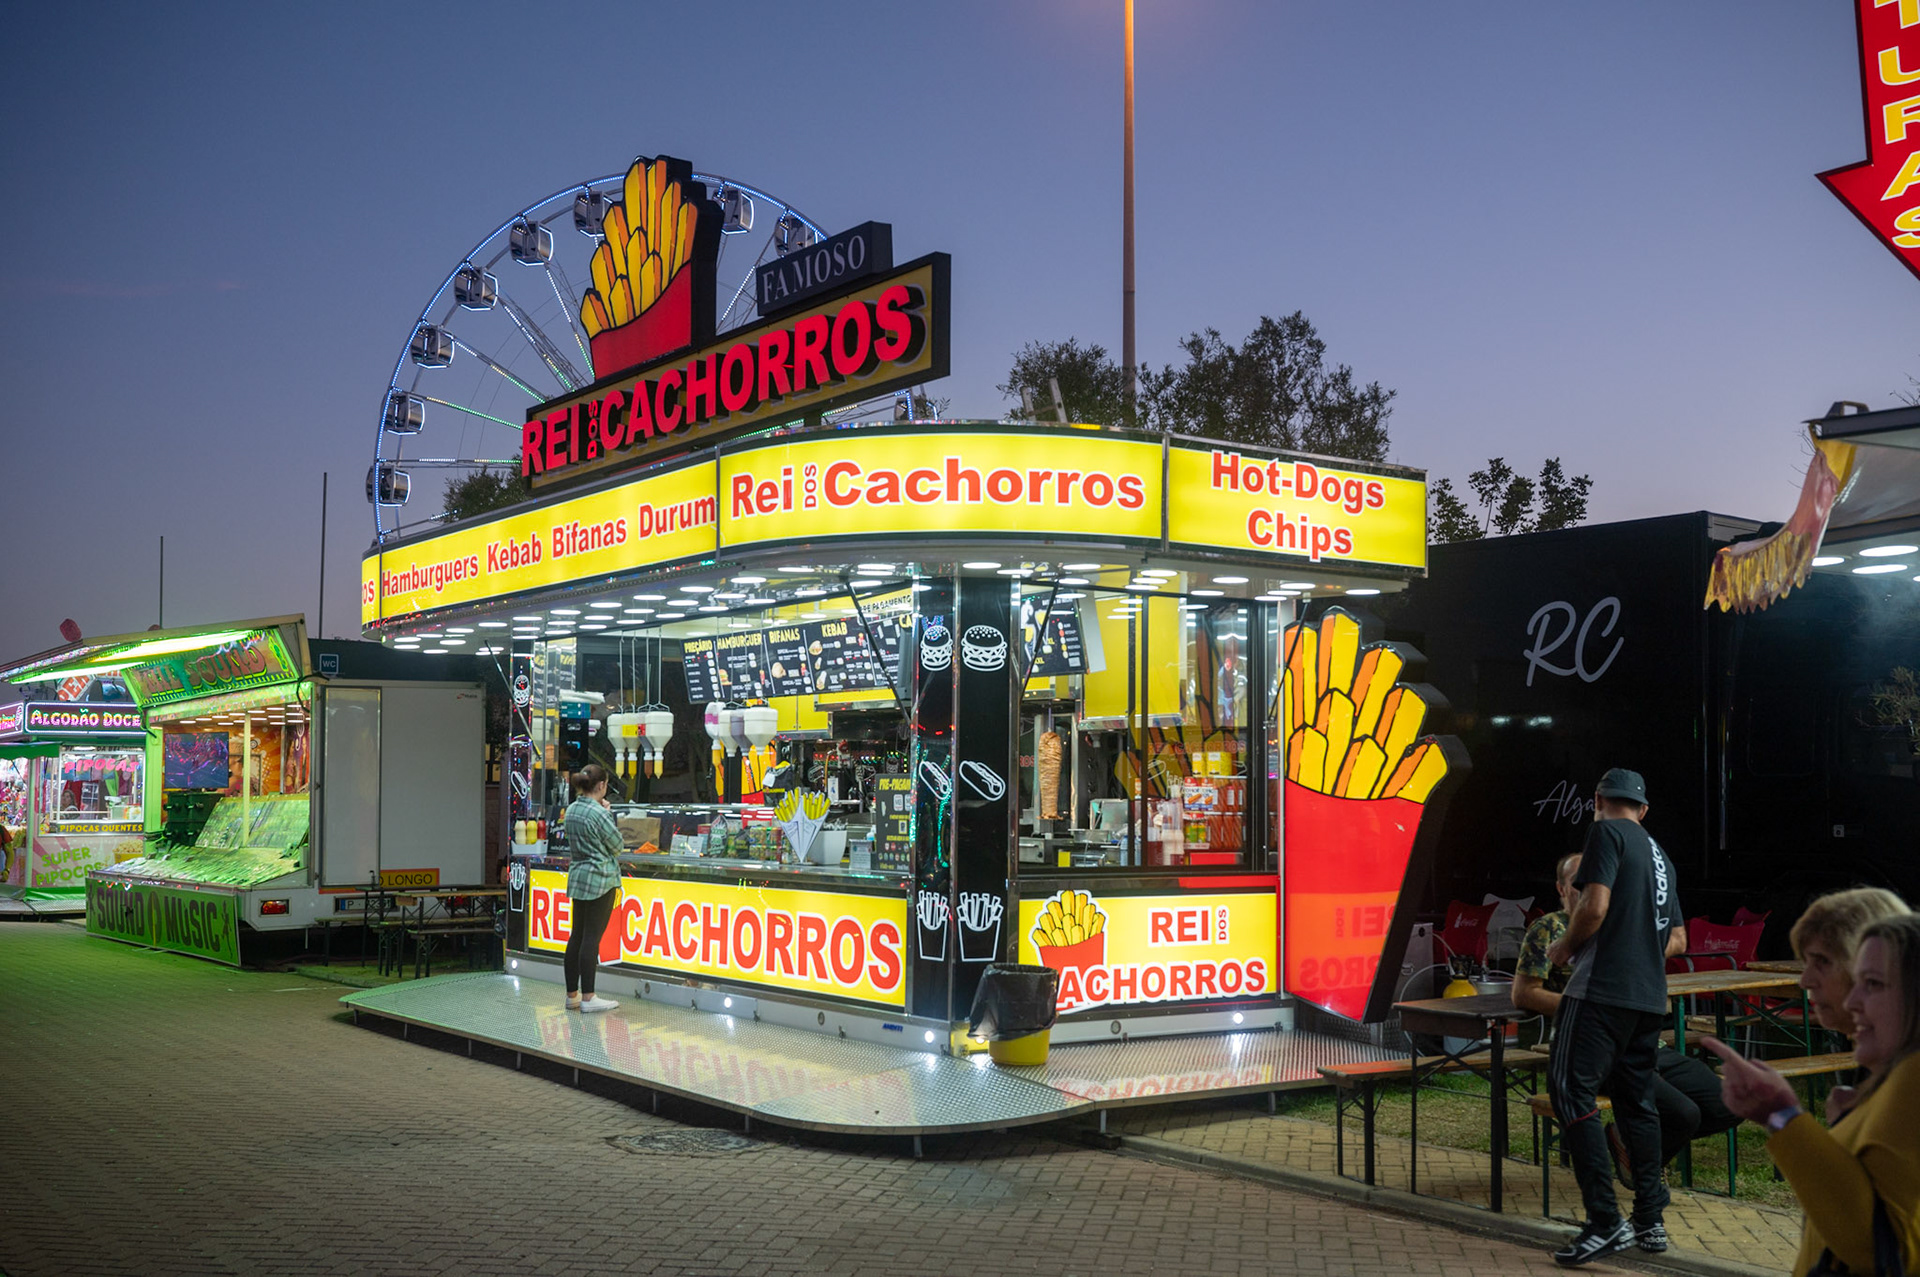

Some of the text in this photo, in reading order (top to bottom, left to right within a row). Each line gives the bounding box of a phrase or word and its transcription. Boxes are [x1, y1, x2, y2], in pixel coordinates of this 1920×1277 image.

[762, 235, 866, 305] FAMOSO
[522, 405, 579, 477] REI
[599, 284, 913, 450] CACHORROS
[731, 458, 1144, 518] Rei DOS Cachorros
[1212, 451, 1384, 514] Hot-Dogs
[381, 495, 715, 597] Hamburguers Kebab Bifanas Durum
[1248, 509, 1352, 560] Chips
[717, 633, 762, 650] HAMBURGUER
[769, 628, 801, 644] BIFANAS
[821, 622, 848, 637] KEBAB
[1523, 596, 1625, 687] RC
[321, 660, 337, 668] WC
[30, 708, 100, 727] ALGODÃO
[103, 712, 141, 727] DOCE
[64, 758, 139, 774] PIPOCAS
[59, 823, 143, 833] PIPOCAS QUENTES
[42, 847, 92, 868] SUPER
[388, 873, 432, 886] LONGO
[97, 886, 145, 936] SOUND
[164, 895, 221, 952] MUSIC
[1151, 909, 1227, 943] REI DOS
[531, 887, 902, 990] RE CACHORROS
[1058, 961, 1266, 1004] ACHORROS
